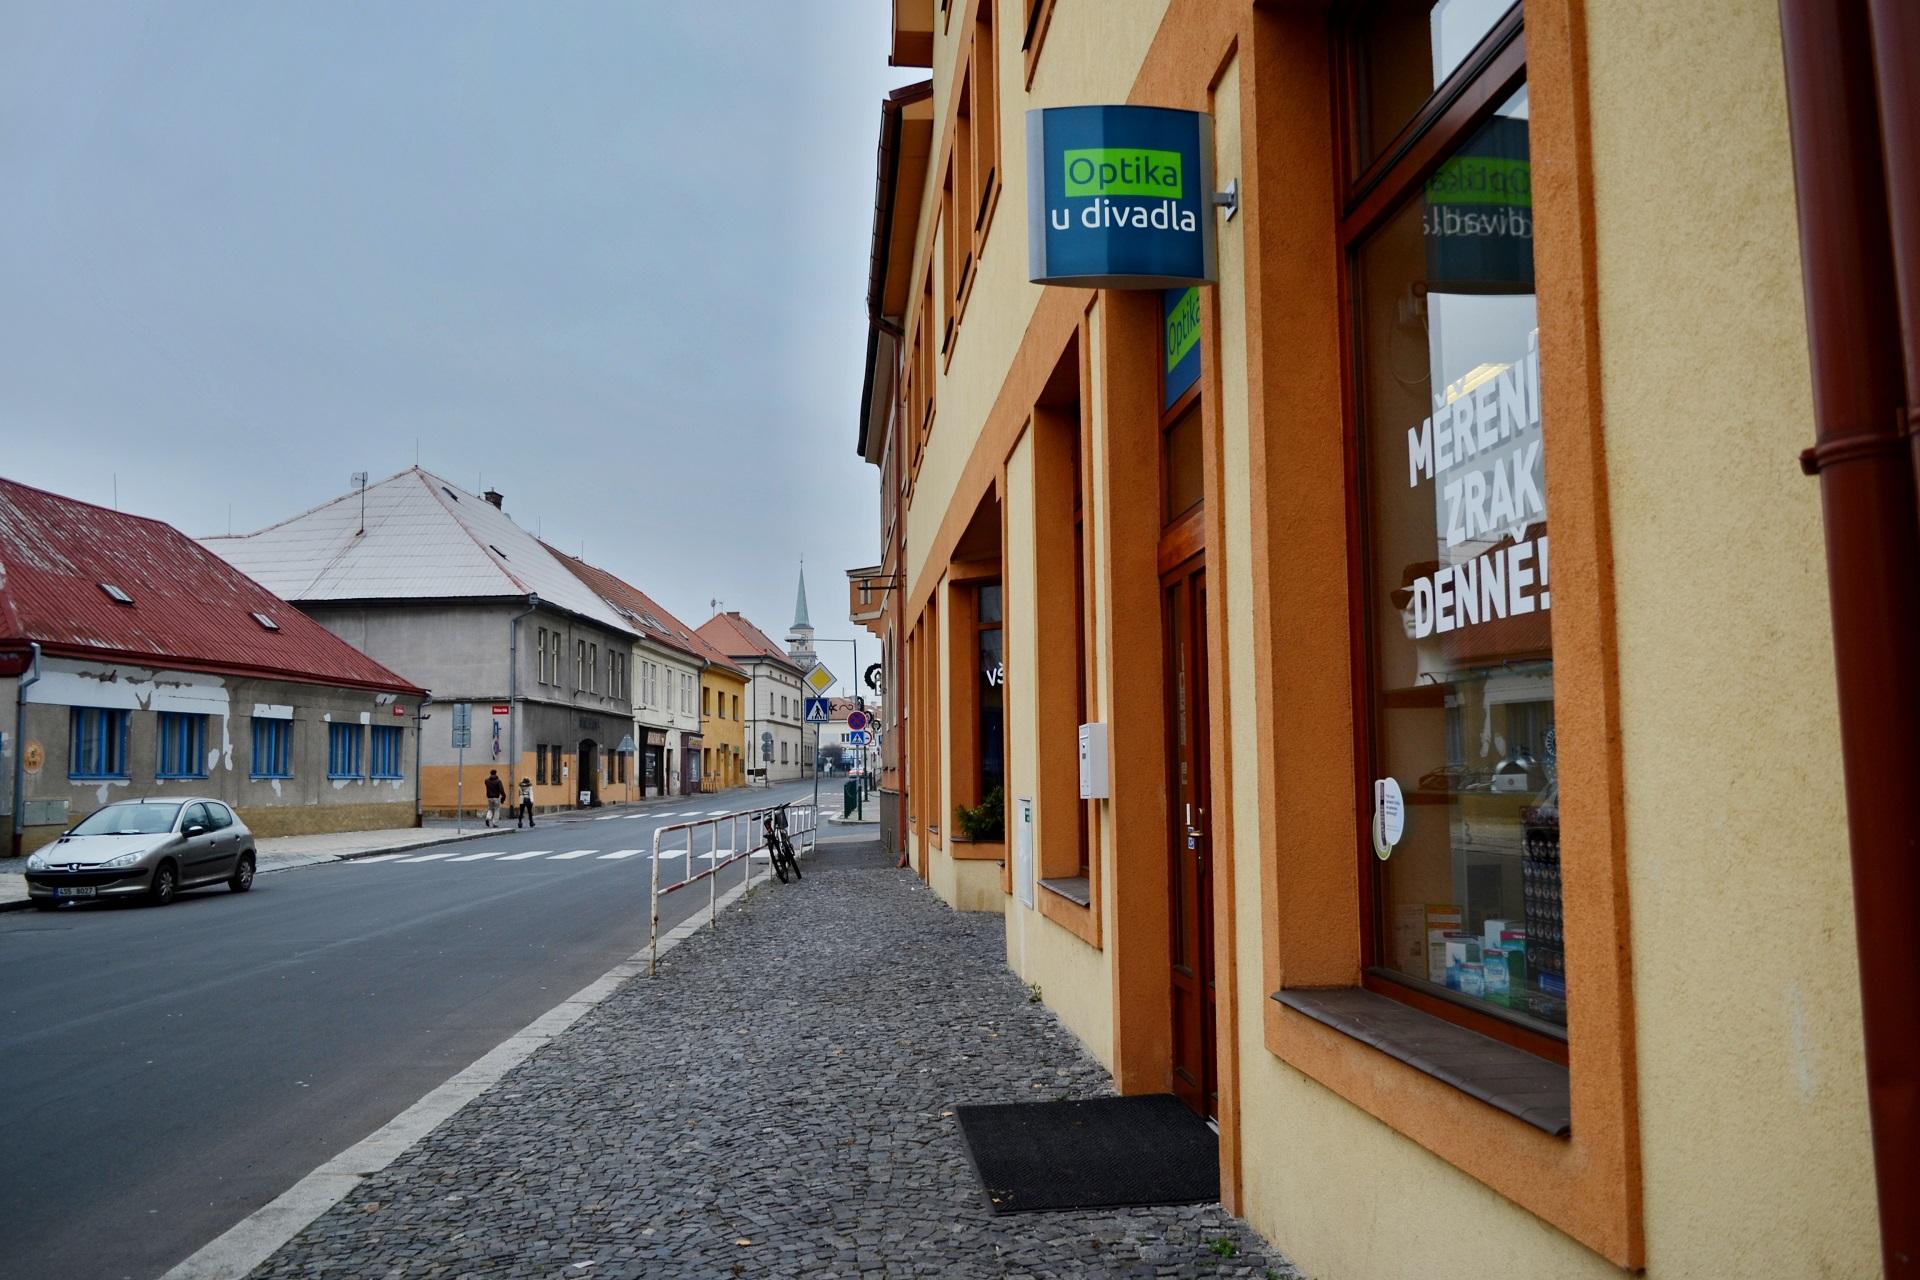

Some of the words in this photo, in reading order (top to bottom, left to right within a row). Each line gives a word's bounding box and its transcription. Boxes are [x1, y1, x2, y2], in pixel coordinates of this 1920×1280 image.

[1069, 156, 1177, 190] Optika
[1051, 208, 1070, 231] u
[1081, 197, 1196, 232] divadla
[1408, 328, 1540, 488] MĚŘENÍ
[1412, 522, 1551, 639] DENNĚ!
